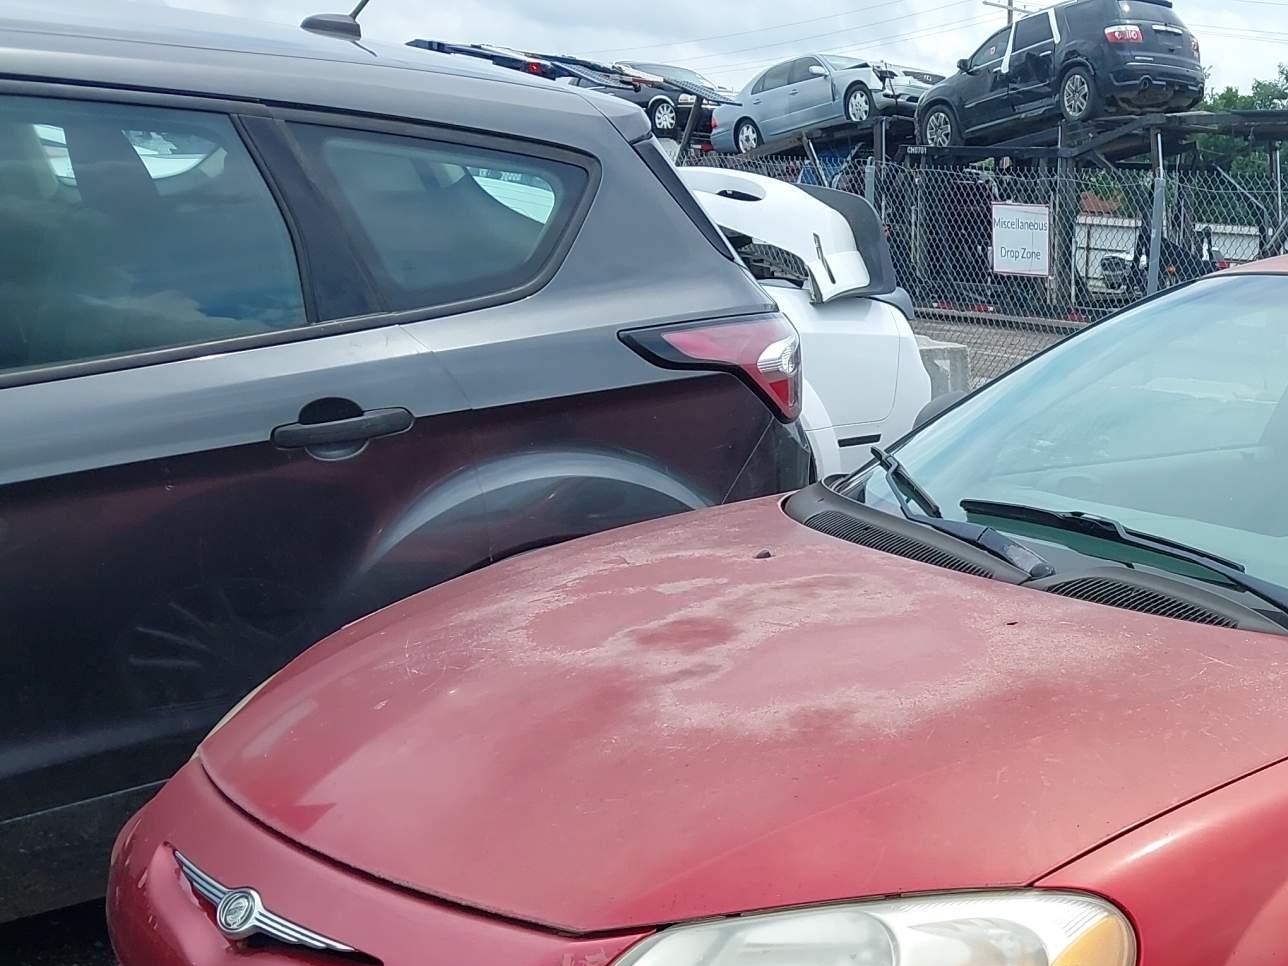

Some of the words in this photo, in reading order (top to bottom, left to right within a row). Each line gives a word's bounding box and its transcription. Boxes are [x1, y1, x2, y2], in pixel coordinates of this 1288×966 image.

[993, 217, 1048, 231] Miscellaneous
[1000, 246, 1020, 261] Drop
[1021, 247, 1041, 261] Zone
